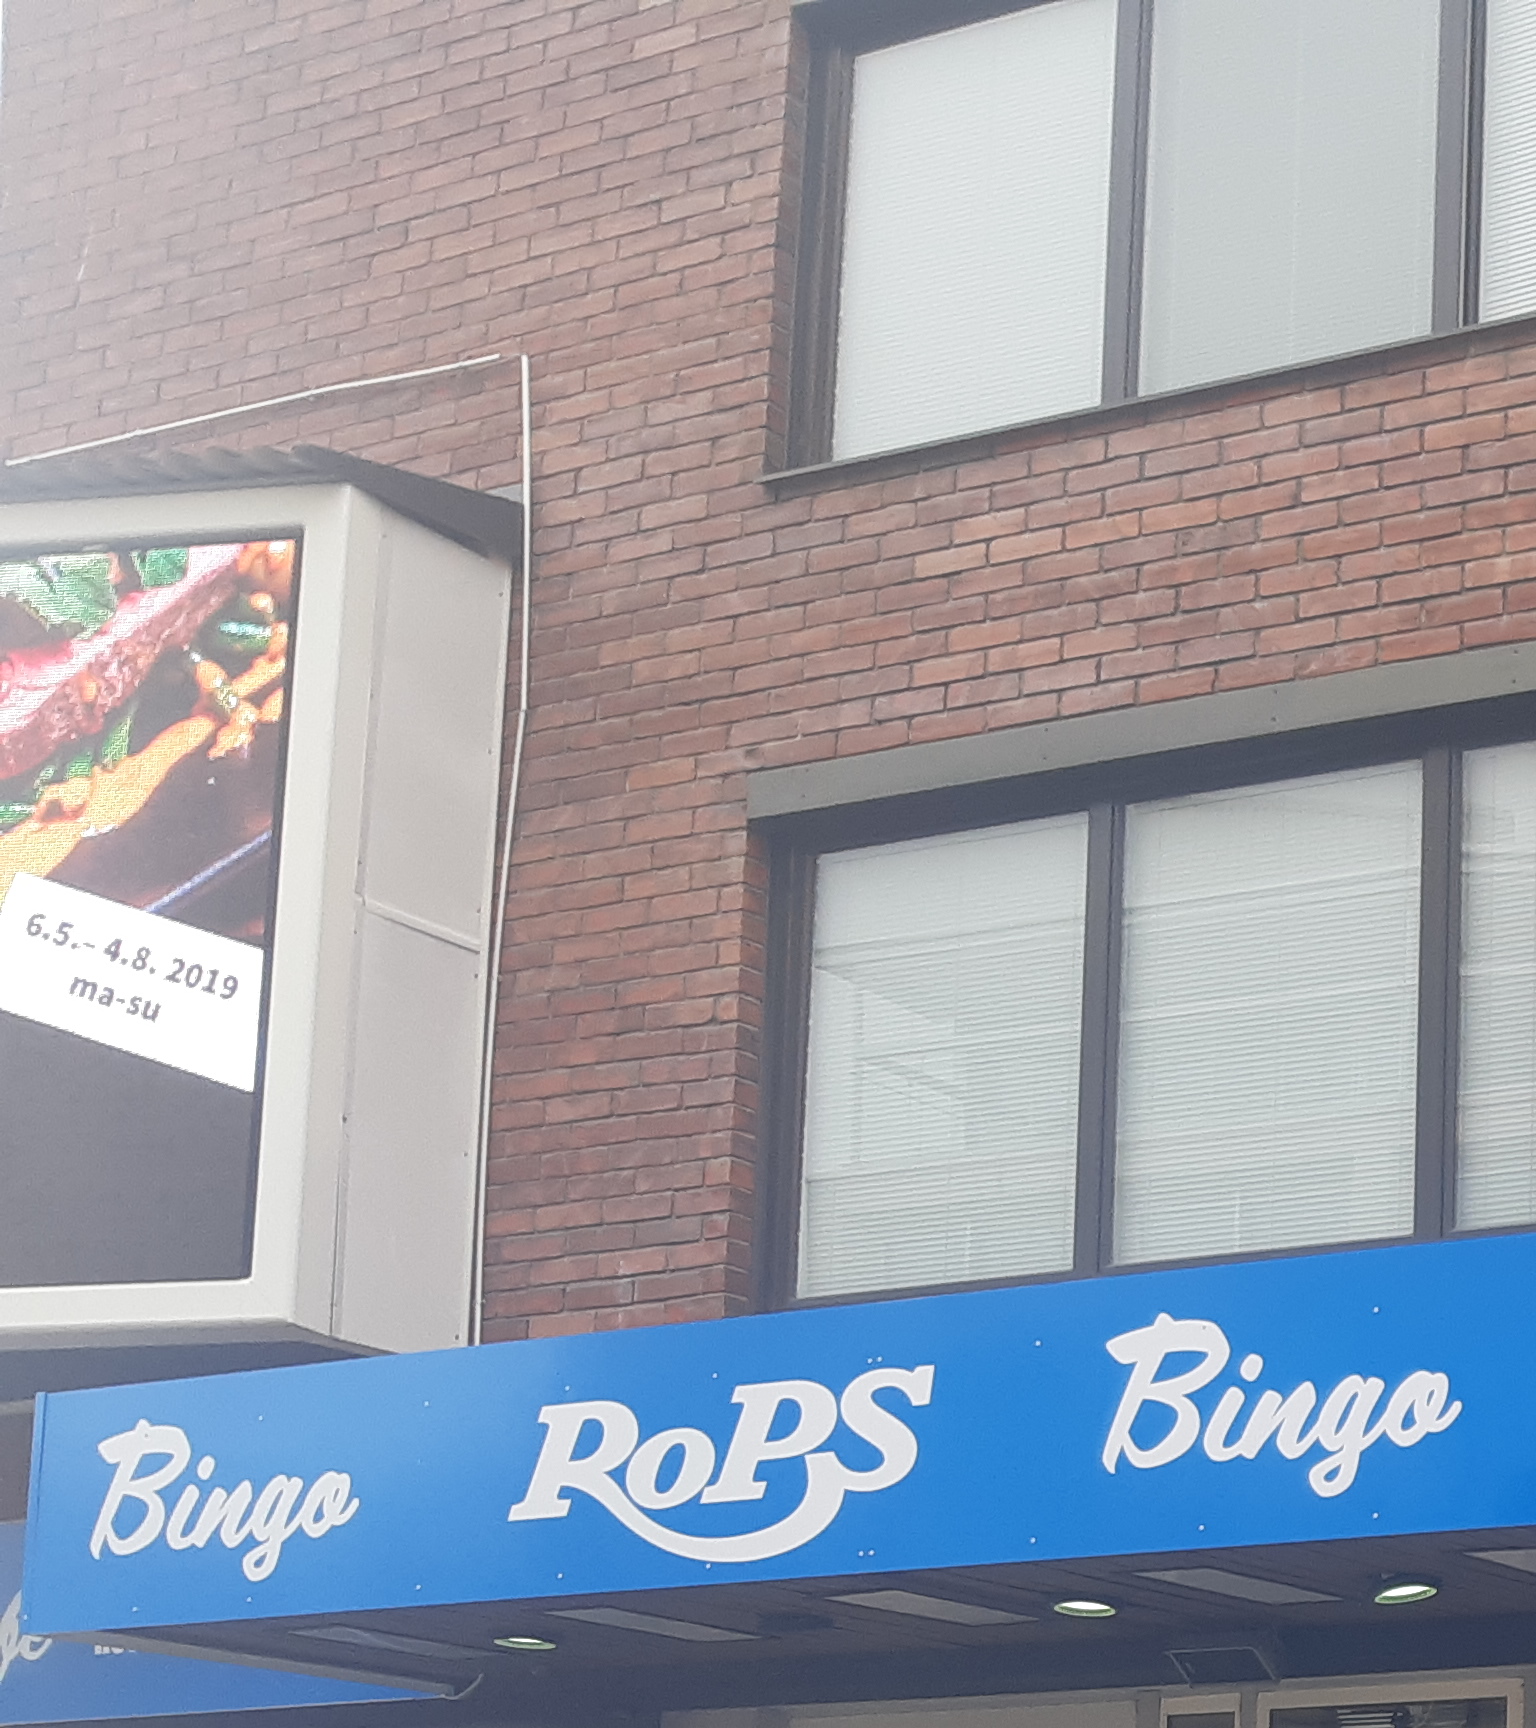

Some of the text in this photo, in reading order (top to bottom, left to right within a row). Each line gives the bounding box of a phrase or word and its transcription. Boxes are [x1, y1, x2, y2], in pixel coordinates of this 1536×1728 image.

[67, 970, 162, 1024] ma-su
[164, 956, 240, 1003] 2019
[508, 1365, 935, 1563] RoPS
[1102, 1312, 1462, 1499] Bingo
[90, 1419, 359, 1582] Bingo
